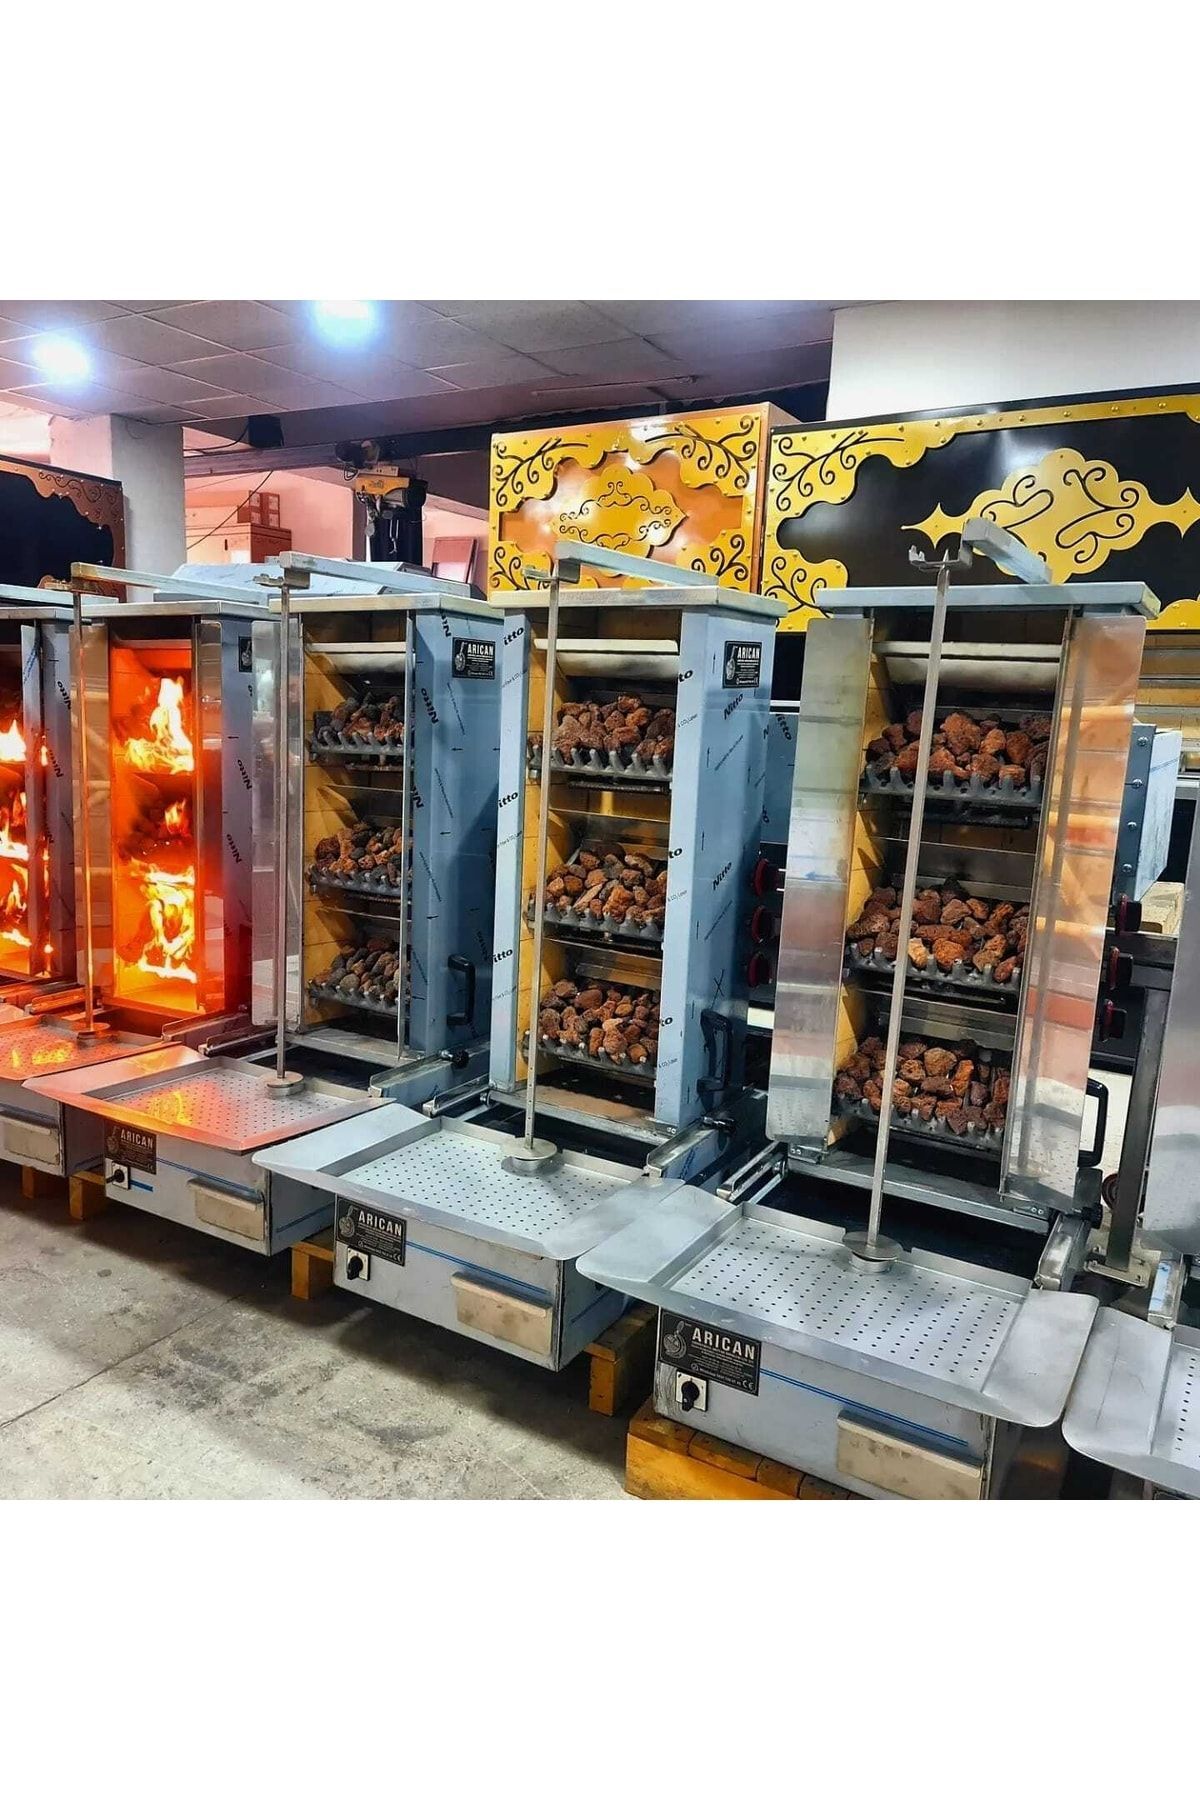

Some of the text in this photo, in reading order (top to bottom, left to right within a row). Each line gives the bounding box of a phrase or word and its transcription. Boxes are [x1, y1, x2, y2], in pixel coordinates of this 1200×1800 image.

[467, 643, 494, 656] ARICAN
[503, 626, 525, 646] itto
[421, 687, 439, 725] Nitto
[723, 693, 744, 721] Nitto
[237, 758, 252, 790] Nitto
[498, 790, 519, 809] itto
[226, 833, 242, 864] Nitto
[712, 861, 733, 892] Nitto
[492, 948, 514, 964] itto
[120, 1128, 154, 1150] ARICAN
[358, 1210, 402, 1237] ARICAN
[692, 1326, 755, 1361] ARICAN
